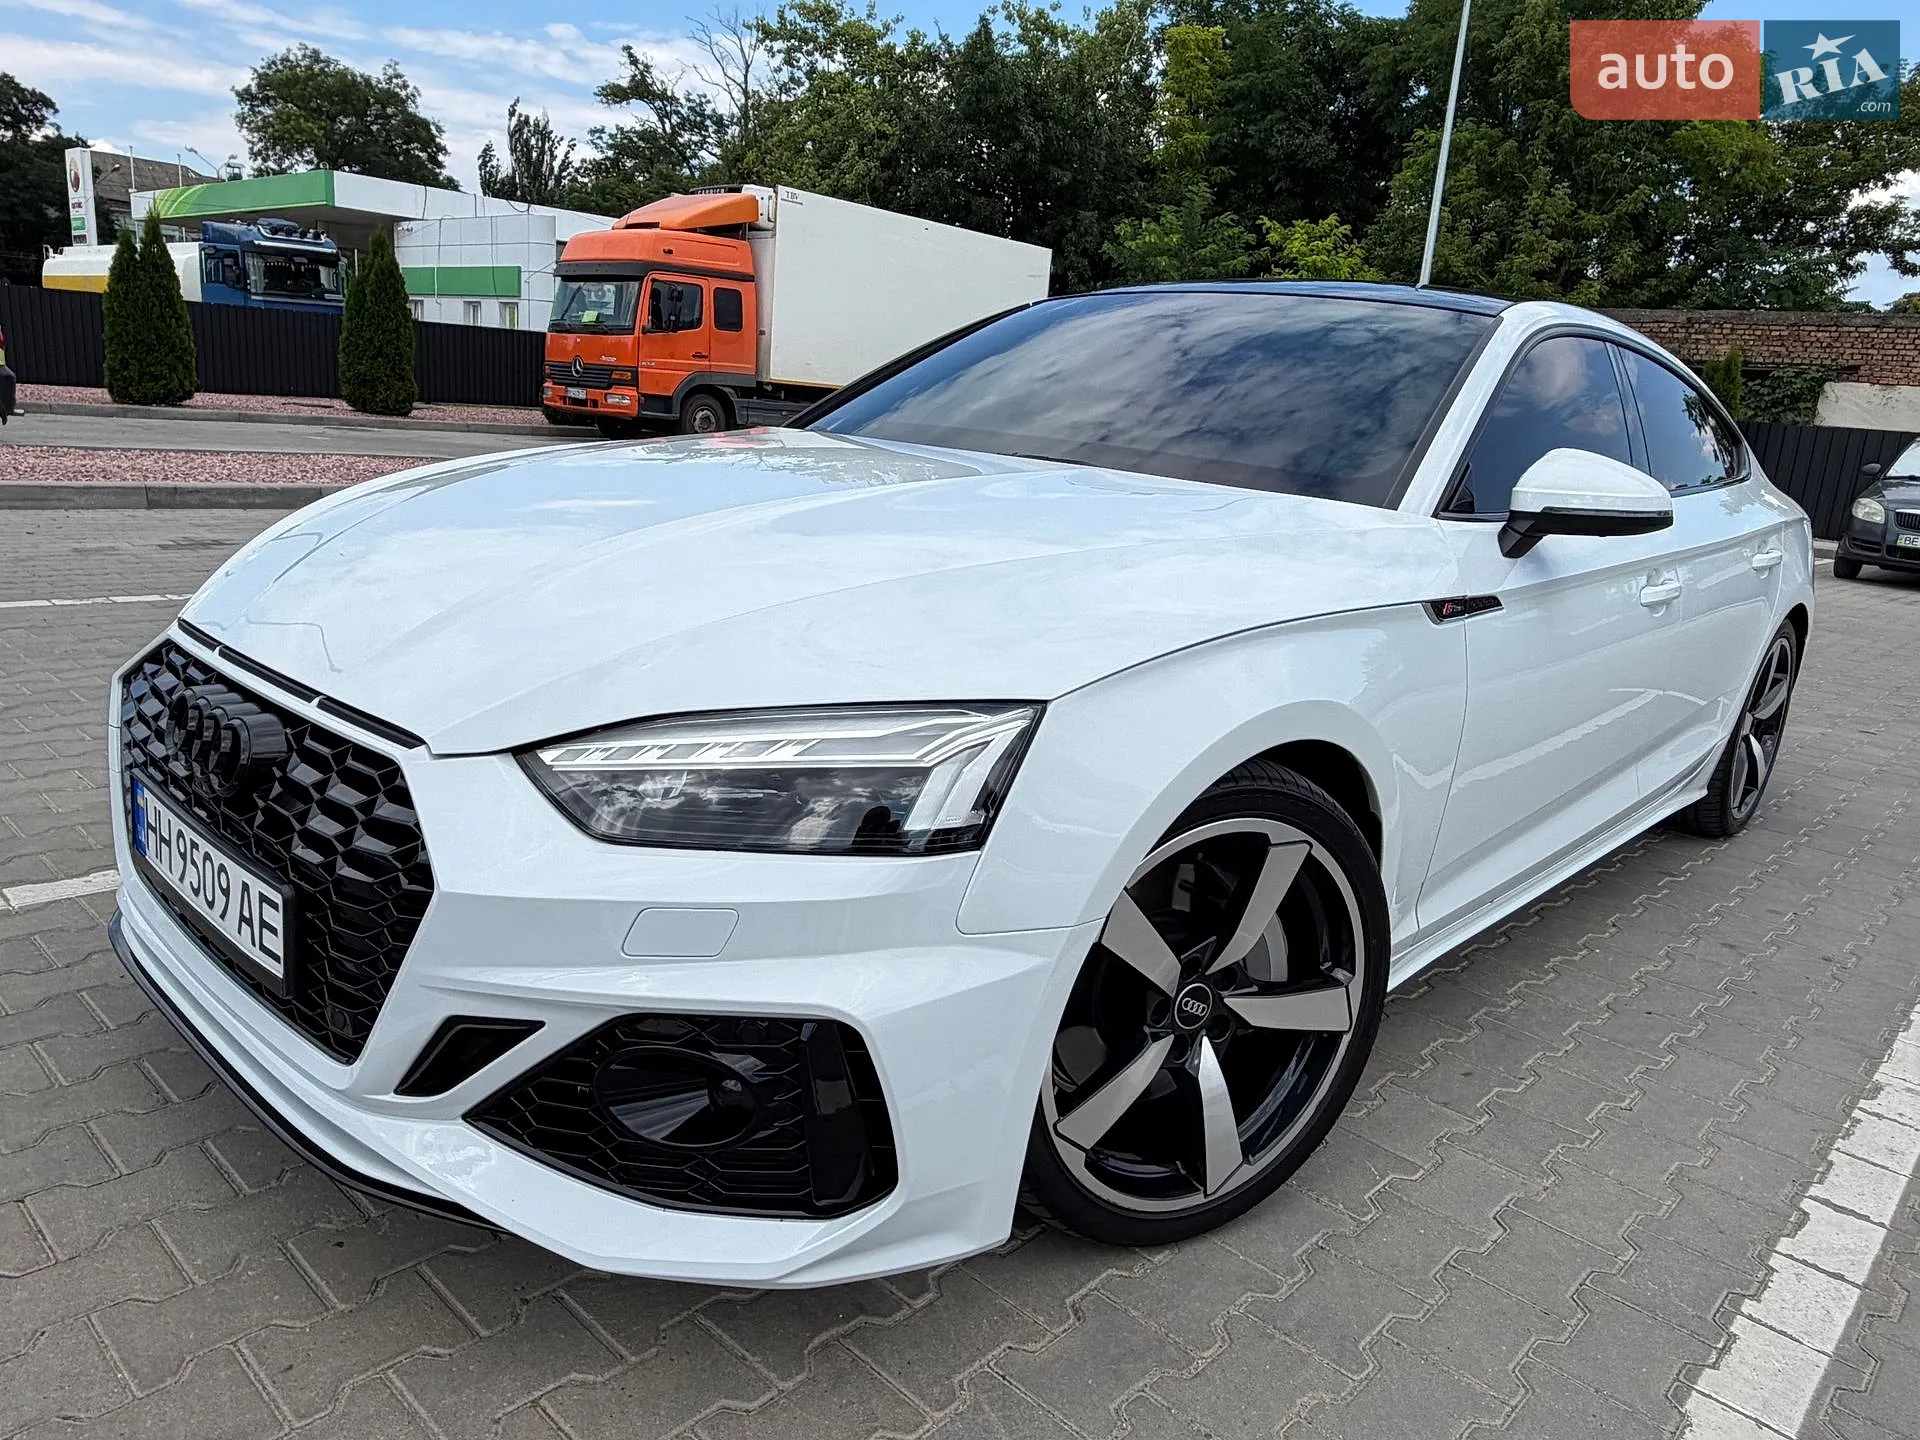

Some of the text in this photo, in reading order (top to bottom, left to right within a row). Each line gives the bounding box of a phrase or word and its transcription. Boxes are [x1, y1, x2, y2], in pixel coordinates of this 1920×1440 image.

[1904, 536, 1919, 546] BE
[145, 797, 282, 965] HH 9509 AE
